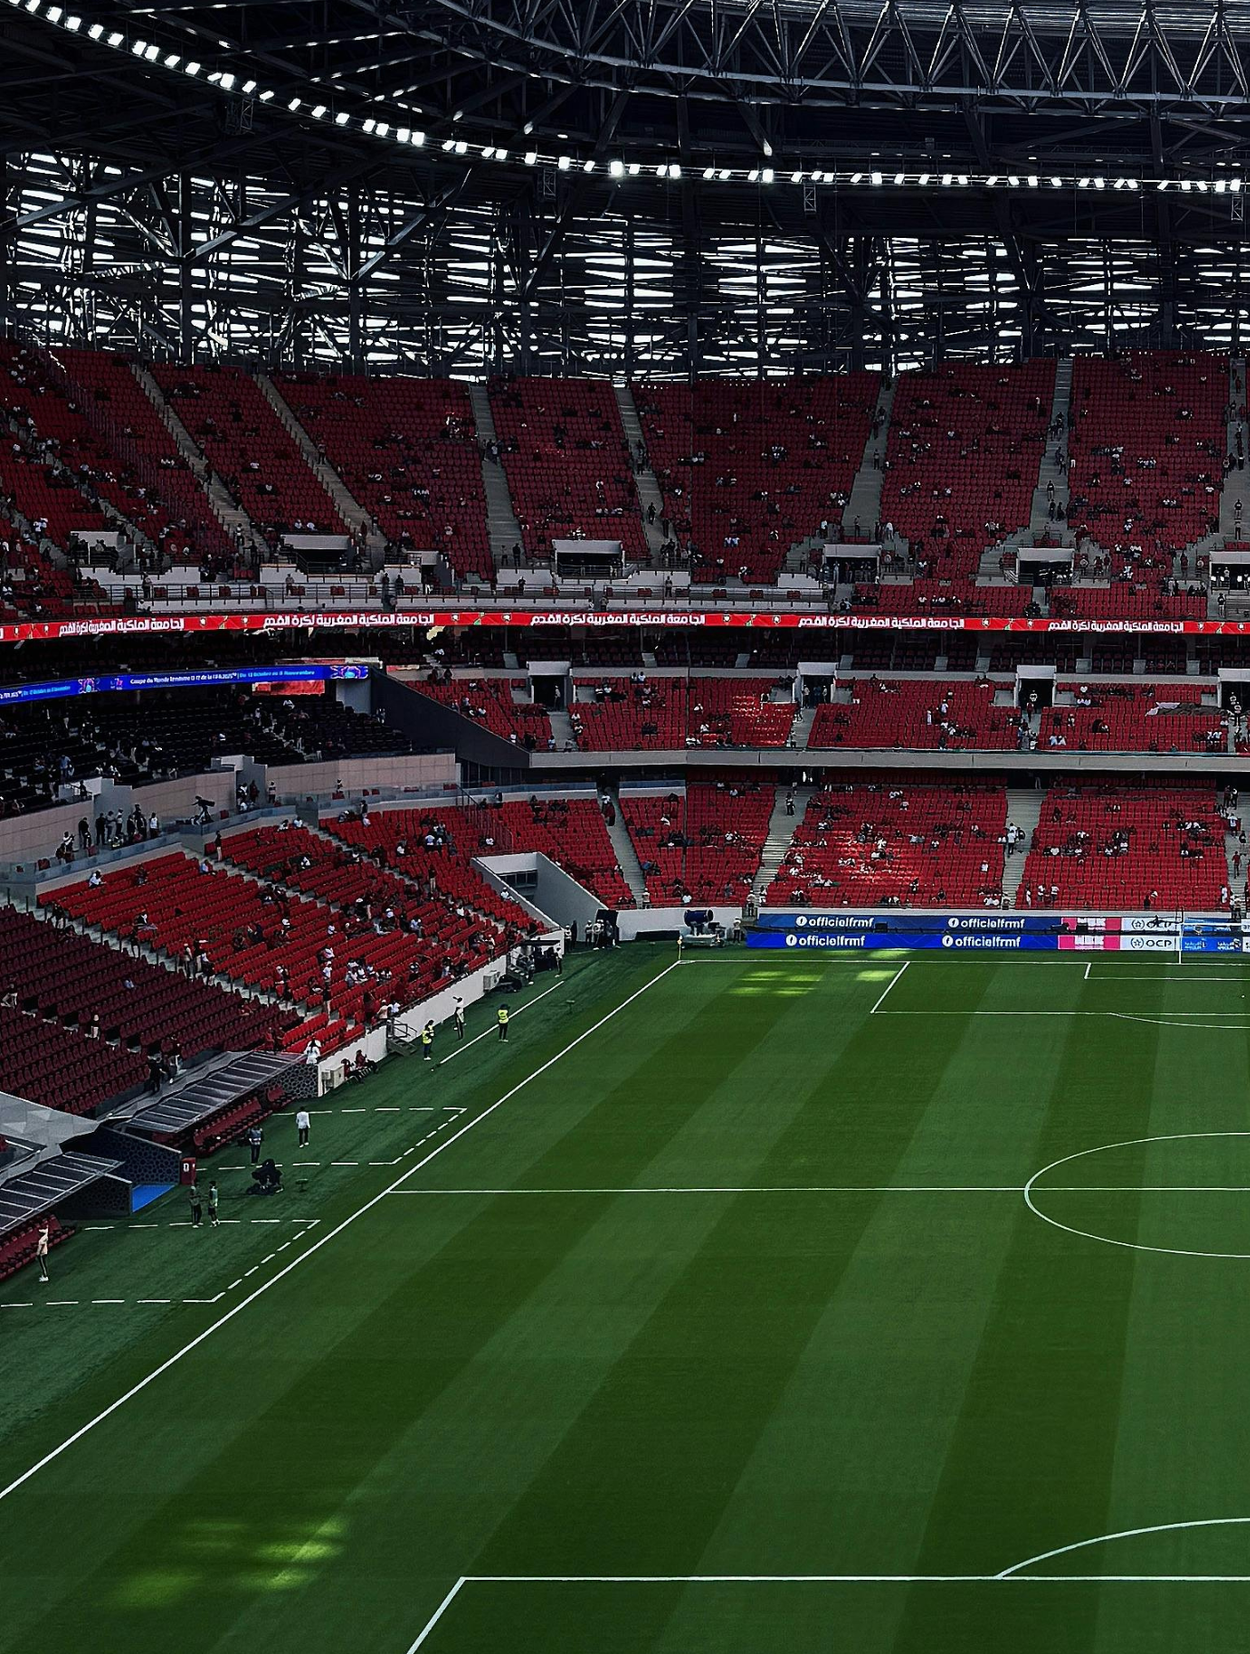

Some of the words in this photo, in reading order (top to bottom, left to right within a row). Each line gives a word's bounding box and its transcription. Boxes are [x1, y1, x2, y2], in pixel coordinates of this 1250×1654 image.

[264, 616, 290, 628] القدم
[292, 615, 314, 627] لكرة
[316, 614, 357, 627] المغربية
[359, 614, 394, 626] الملكية
[396, 614, 434, 626] الجامعة
[531, 615, 561, 626] القدم
[562, 614, 586, 626] لكرة
[587, 614, 627, 626] المغربية
[630, 614, 666, 626] الملكية
[667, 614, 705, 626] الجامعة
[809, 916, 874, 928] officialfrmf
[960, 918, 1025, 929] officialfrmf
[799, 935, 865, 947] officialfrmf
[955, 936, 1021, 947] officialfrmf
[1146, 939, 1171, 947] OCP
